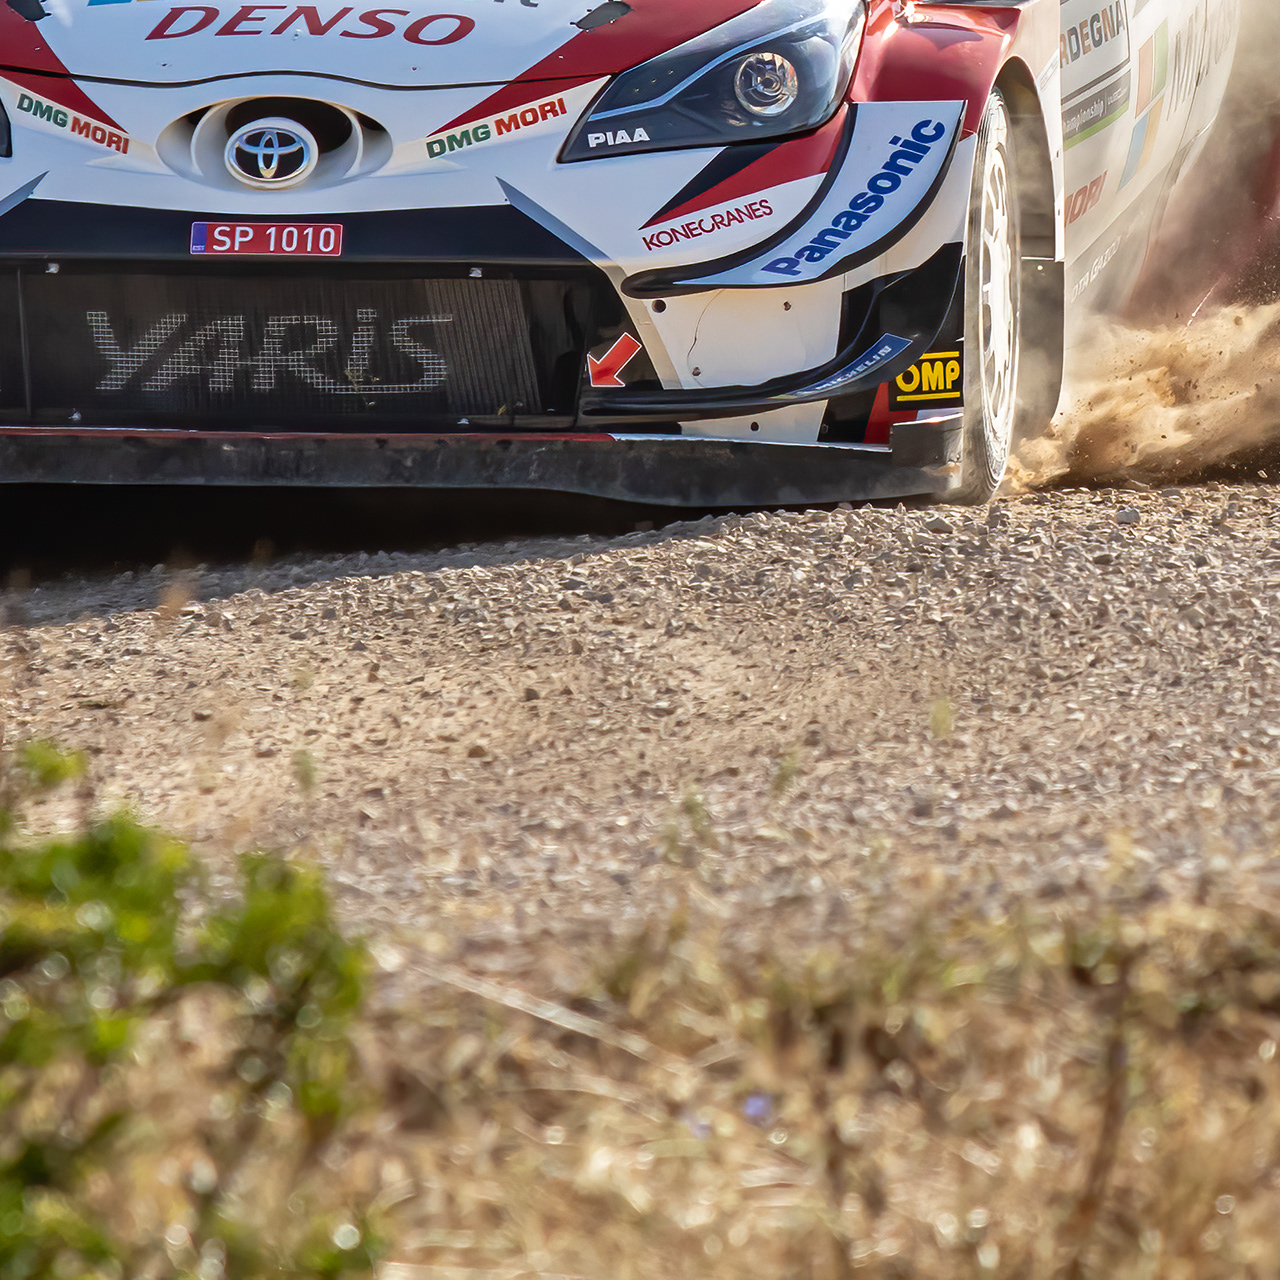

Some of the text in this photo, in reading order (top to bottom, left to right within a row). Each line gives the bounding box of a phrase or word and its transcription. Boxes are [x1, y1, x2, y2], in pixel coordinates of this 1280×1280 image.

[144, 5, 476, 46] DENSO
[17, 93, 130, 155] DMG MORI
[426, 97, 568, 159] DMG MORI
[587, 127, 651, 148] PIAA
[761, 119, 946, 276] Panasonic
[212, 226, 335, 252] SP 1010
[642, 199, 773, 251] KONECRANES
[896, 359, 960, 393] OMP
